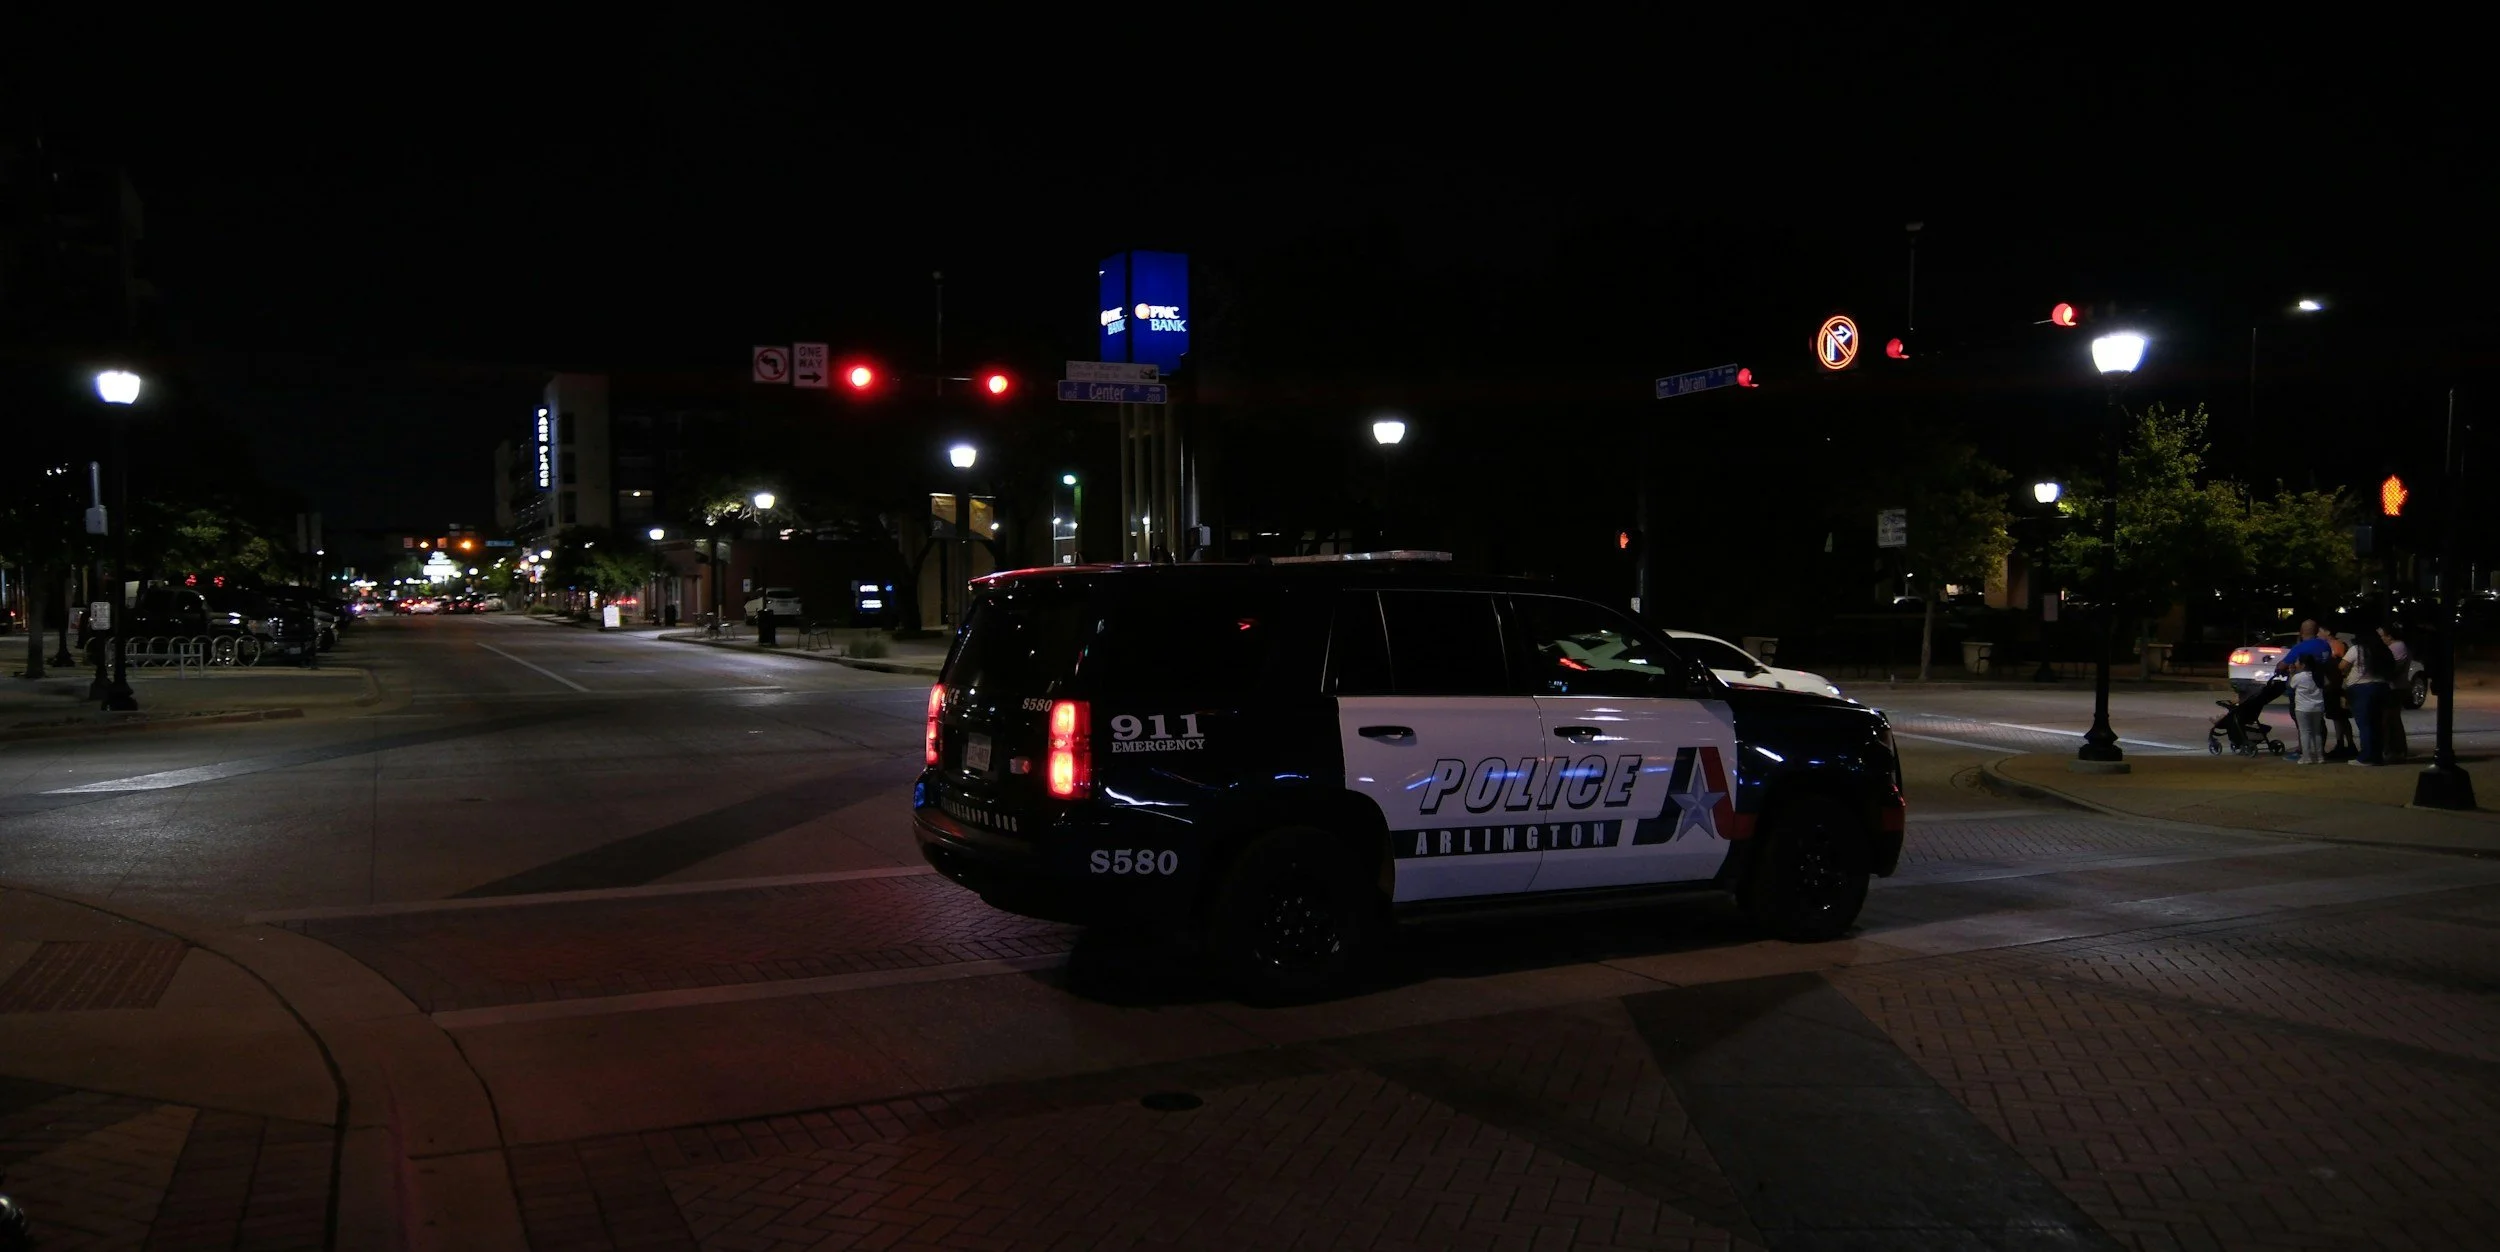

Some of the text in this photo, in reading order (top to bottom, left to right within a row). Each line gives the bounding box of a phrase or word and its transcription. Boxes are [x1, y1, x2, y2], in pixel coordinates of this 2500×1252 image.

[1149, 305, 1180, 319] PNC
[1107, 318, 1126, 335] BANK
[1149, 318, 1187, 332] BANK
[799, 346, 822, 357] ONE
[799, 359, 823, 368] WAY
[1089, 383, 1126, 401] Center
[1679, 375, 1707, 393] Abram
[1146, 393, 1161, 401] 200
[538, 408, 549, 487] PARK PLACE
[1021, 697, 1053, 713] S580
[1110, 713, 1205, 741] 911
[1111, 738, 1206, 753] EMERGENCY
[1420, 754, 1643, 815] POLICE
[1415, 822, 1605, 856] ARLINGTON
[1090, 848, 1179, 876] S580
